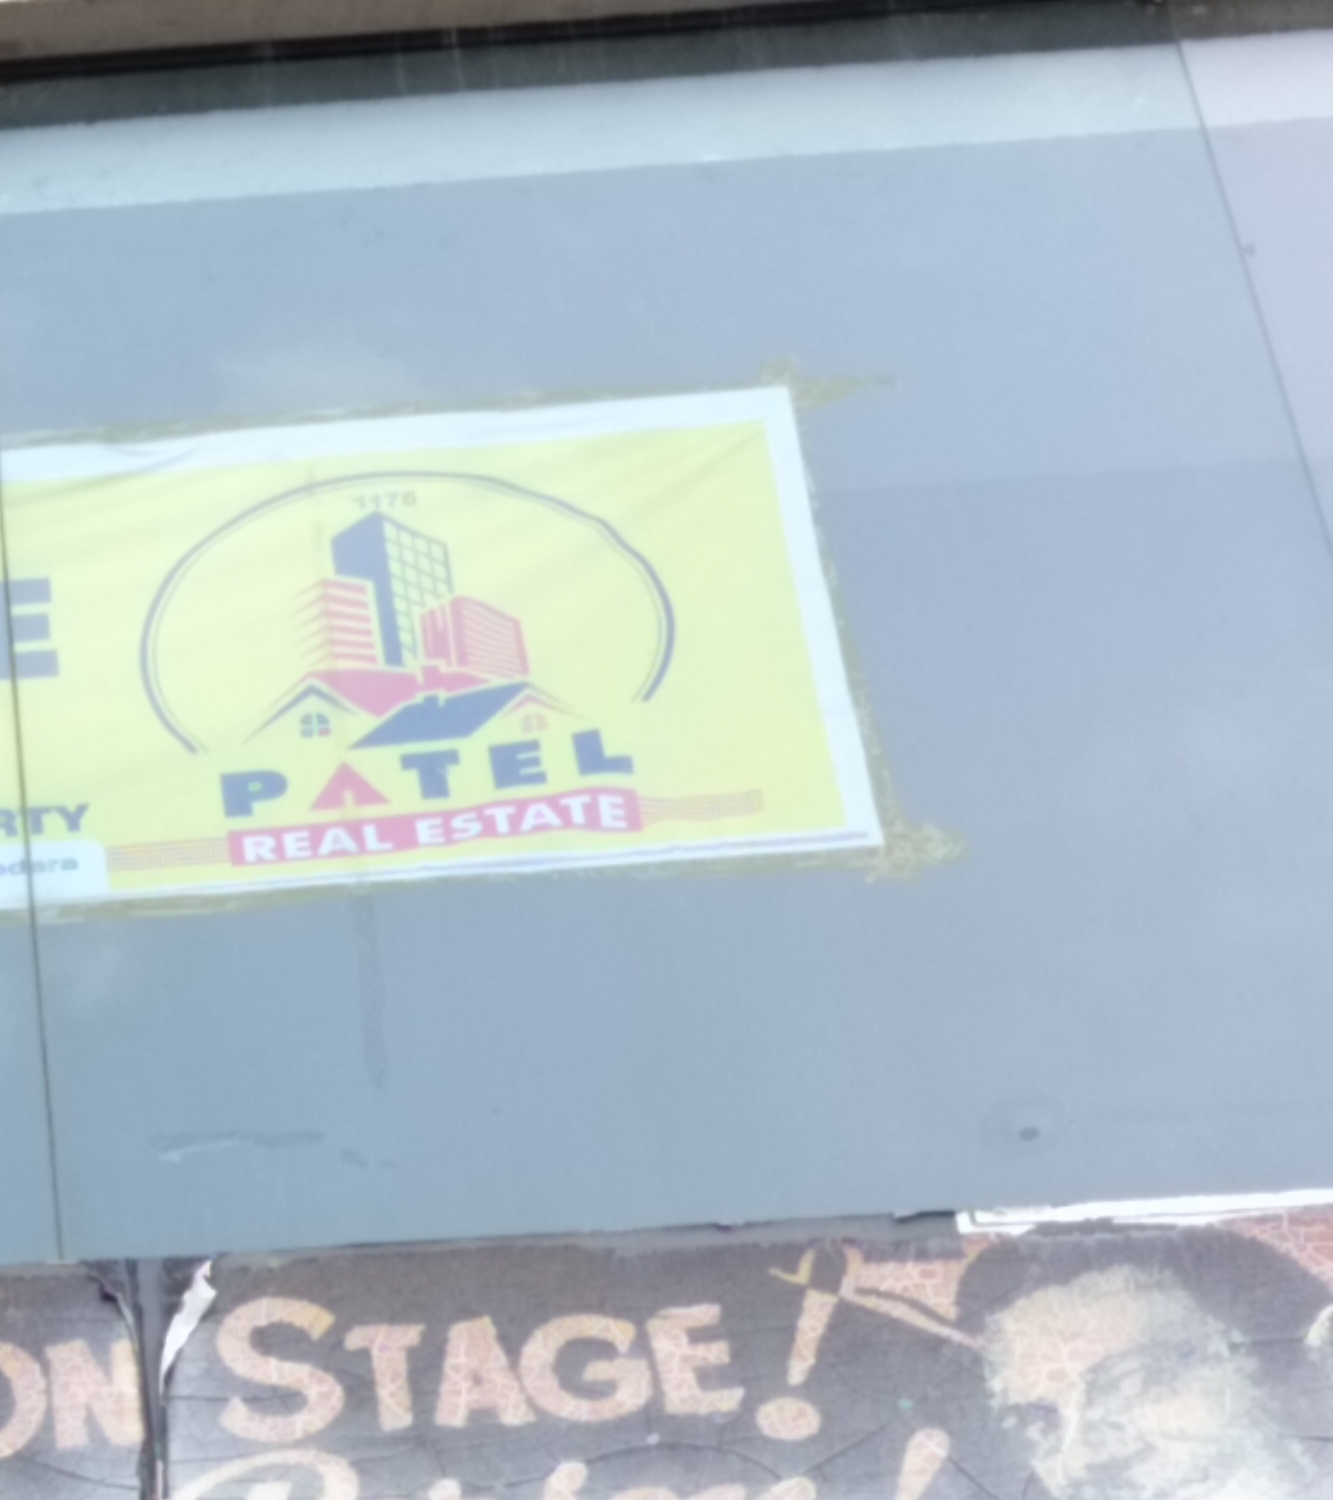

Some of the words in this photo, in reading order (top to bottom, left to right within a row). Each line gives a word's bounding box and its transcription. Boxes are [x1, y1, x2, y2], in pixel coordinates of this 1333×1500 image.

[219, 728, 634, 818] PATEL
[242, 818, 393, 864] REAL
[417, 795, 629, 848] ESTATE
